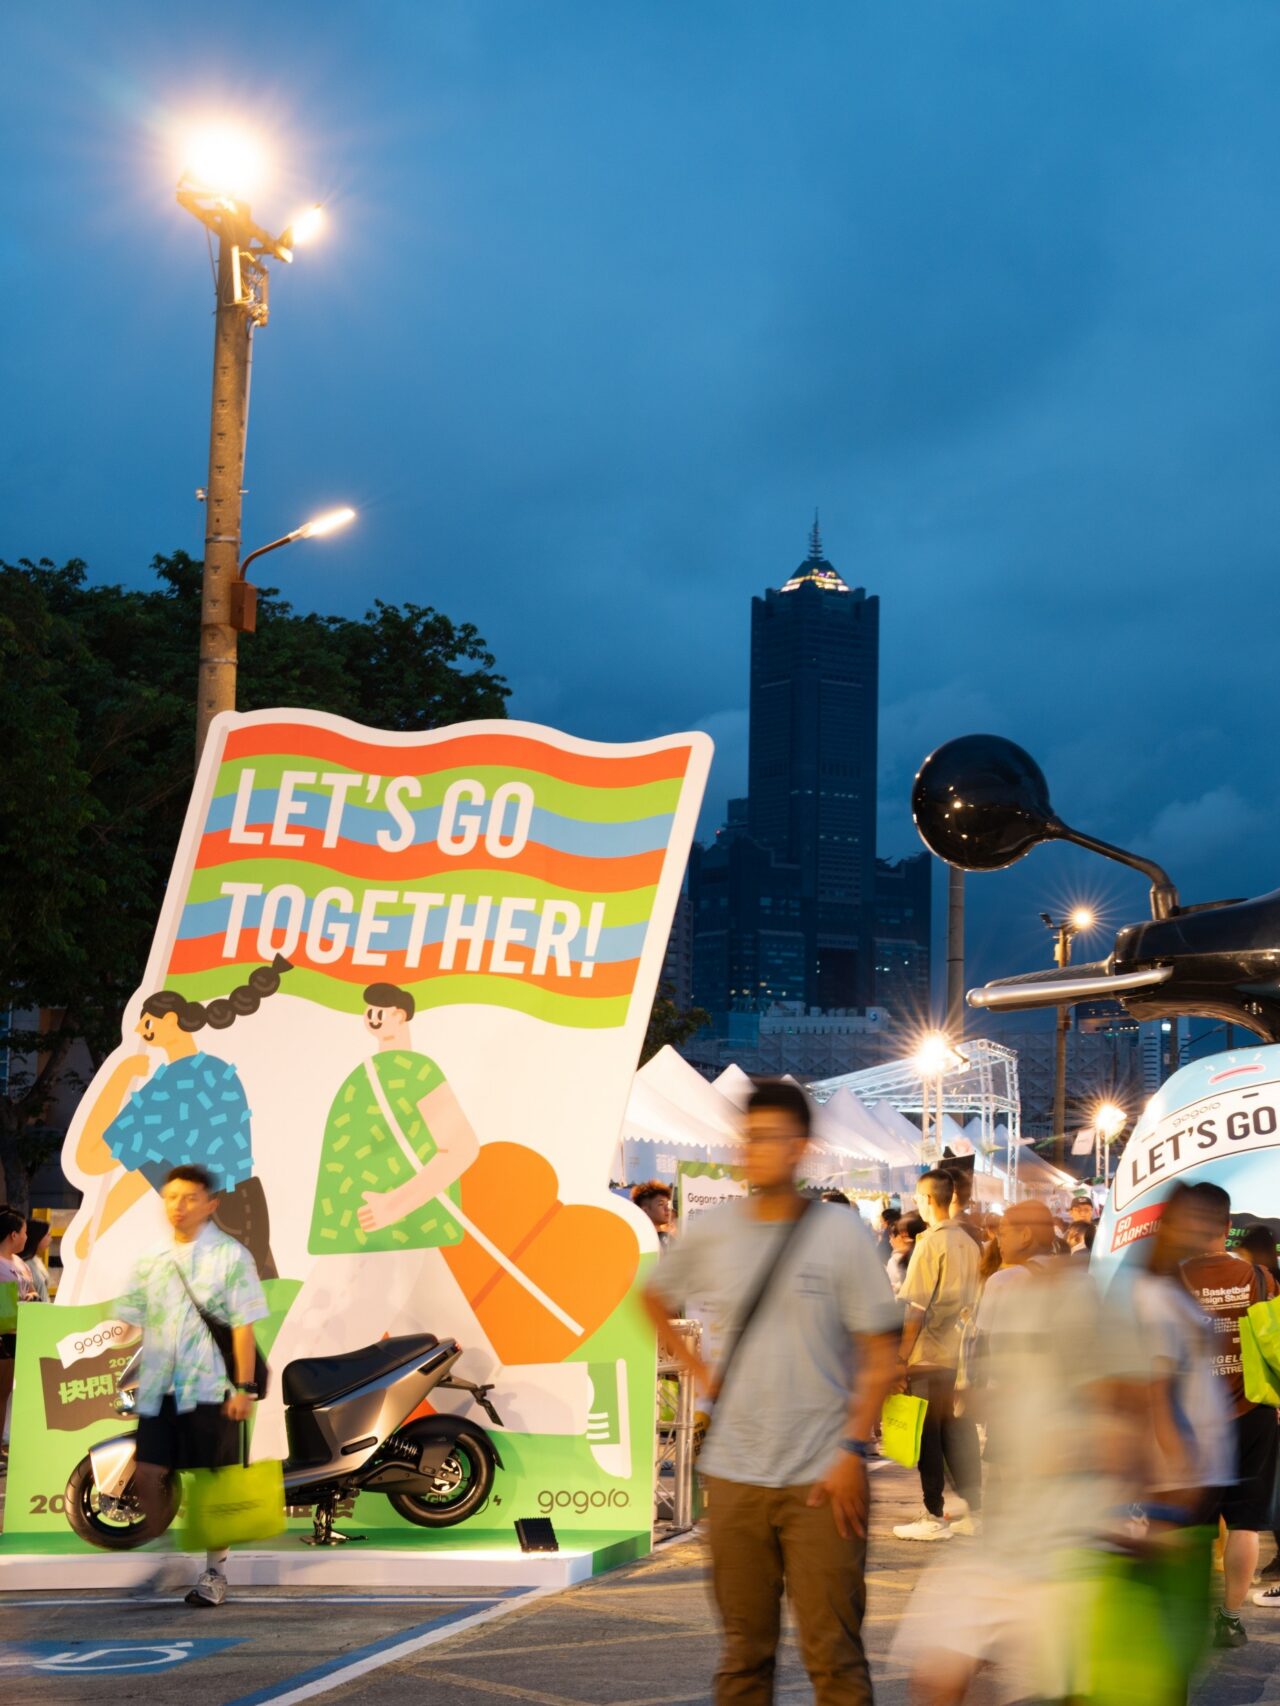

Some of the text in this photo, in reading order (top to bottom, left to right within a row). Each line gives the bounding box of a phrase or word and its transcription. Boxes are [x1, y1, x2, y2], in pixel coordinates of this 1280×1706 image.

[228, 768, 535, 859] LET'S GO
[219, 881, 606, 979] TOGETHER!
[1131, 1105, 1278, 1187] LET'S GO
[1114, 1219, 1162, 1249] KAOHSIU
[1117, 1216, 1132, 1233] GO
[1200, 1294, 1224, 1305] esign
[74, 1326, 124, 1354] gogoro
[1219, 1364, 1243, 1376] STRE
[58, 1371, 122, 1405] 快閃
[537, 1488, 630, 1514] gogoro
